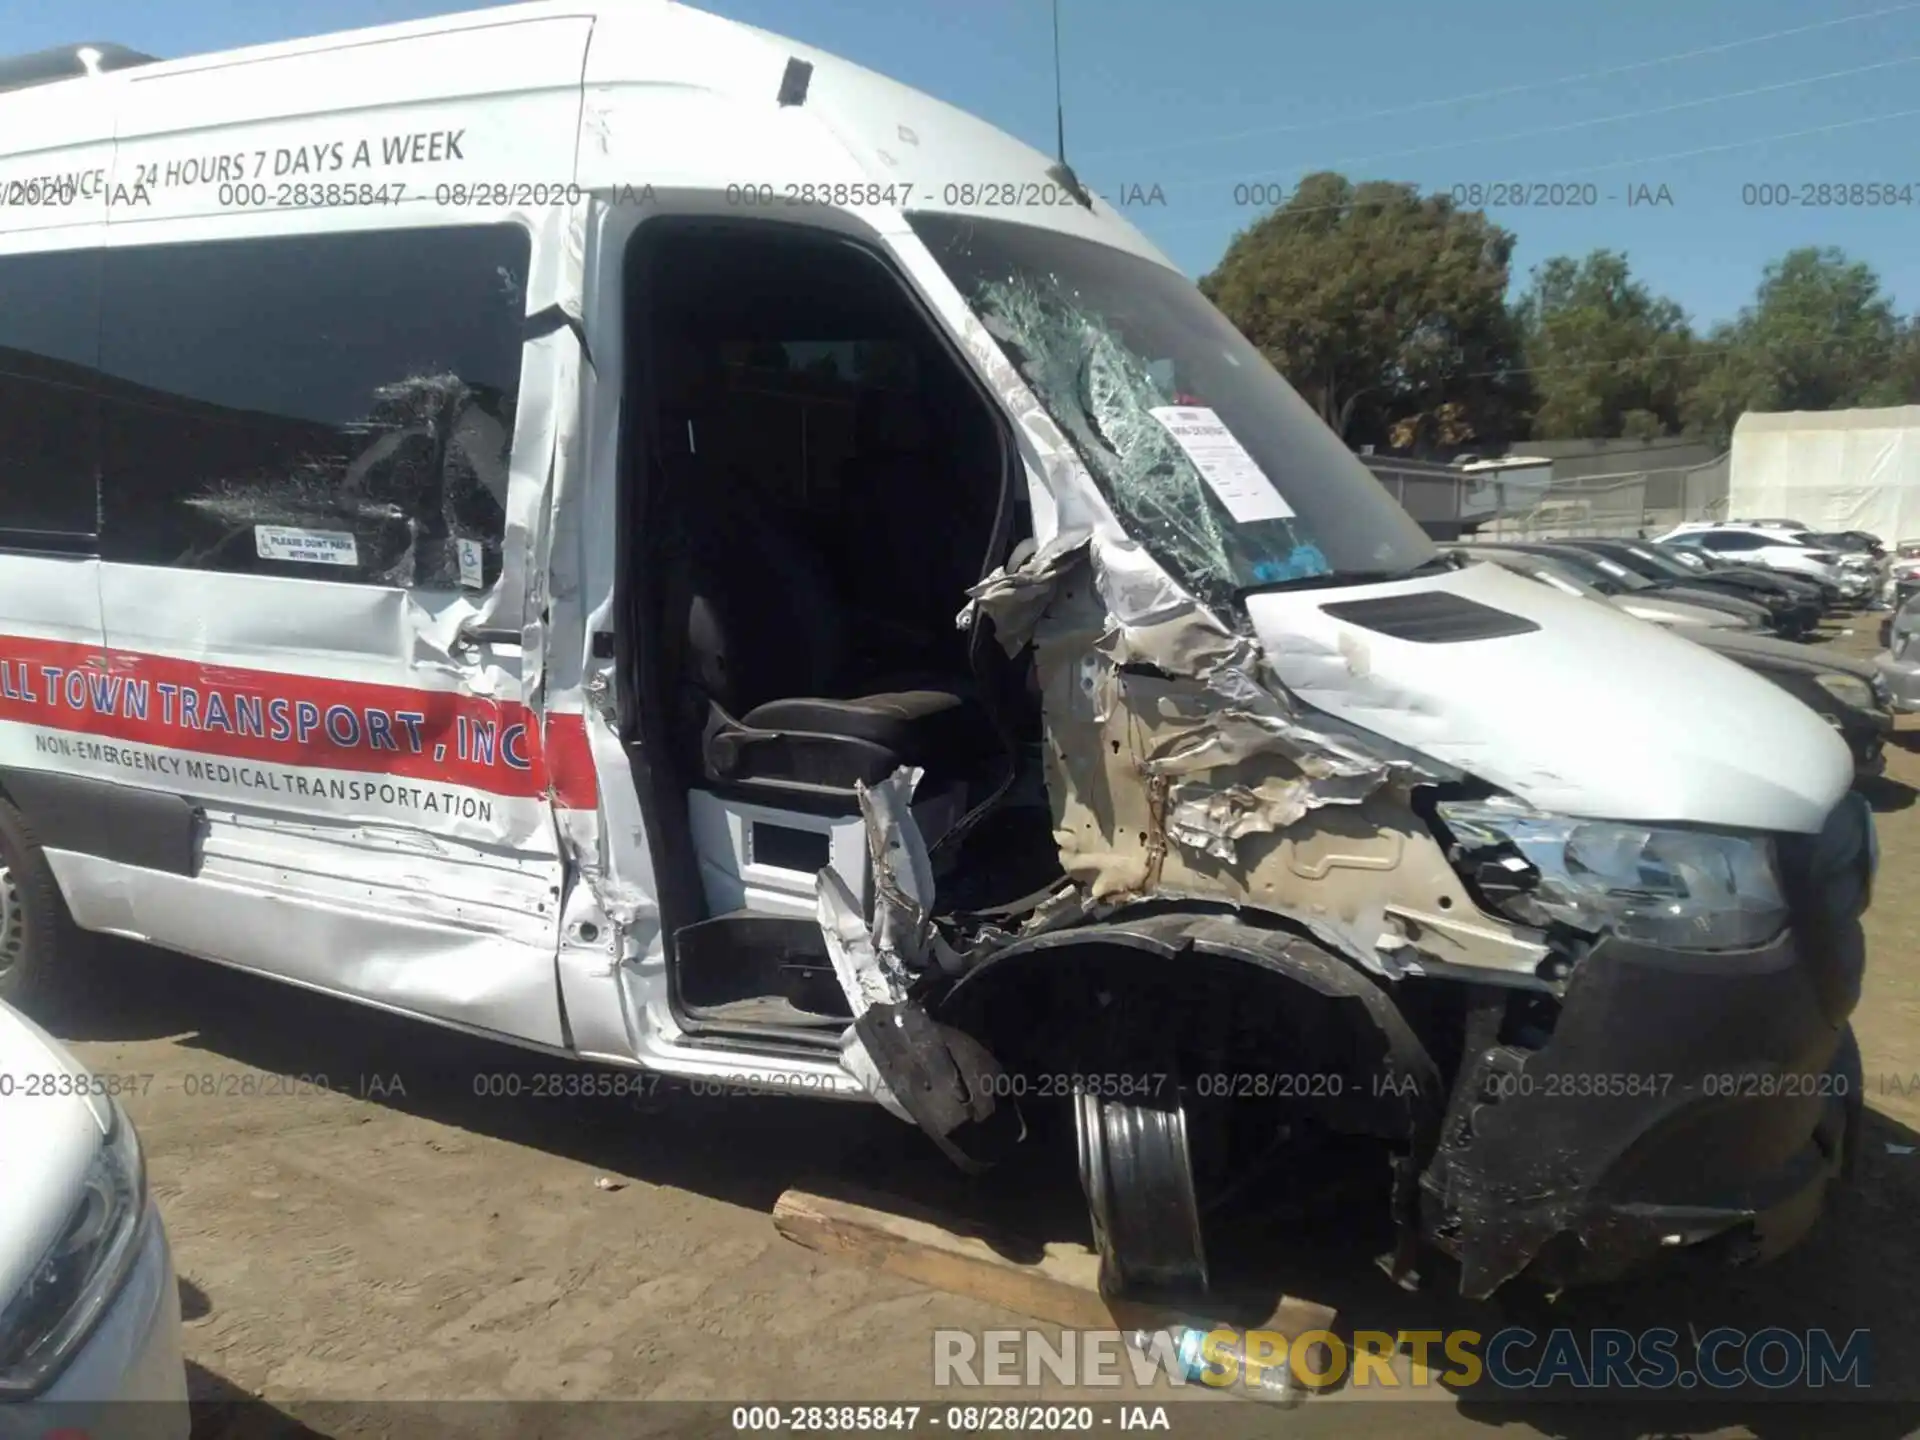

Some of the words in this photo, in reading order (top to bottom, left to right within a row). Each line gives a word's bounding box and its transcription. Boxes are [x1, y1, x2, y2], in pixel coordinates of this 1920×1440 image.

[134, 163, 158, 189] 24
[165, 152, 244, 187] HOURS
[254, 151, 266, 178] 7
[274, 141, 343, 175] DAYS
[352, 139, 371, 168] A
[382, 129, 466, 165] WEEK
[0, 660, 37, 702] LL
[41, 665, 151, 721] TOWN
[456, 716, 533, 770] INC
[35, 734, 181, 776] NON-EMERGENCY
[187, 759, 281, 791] MEDICAL
[282, 774, 493, 823] TRANSPORTATION
